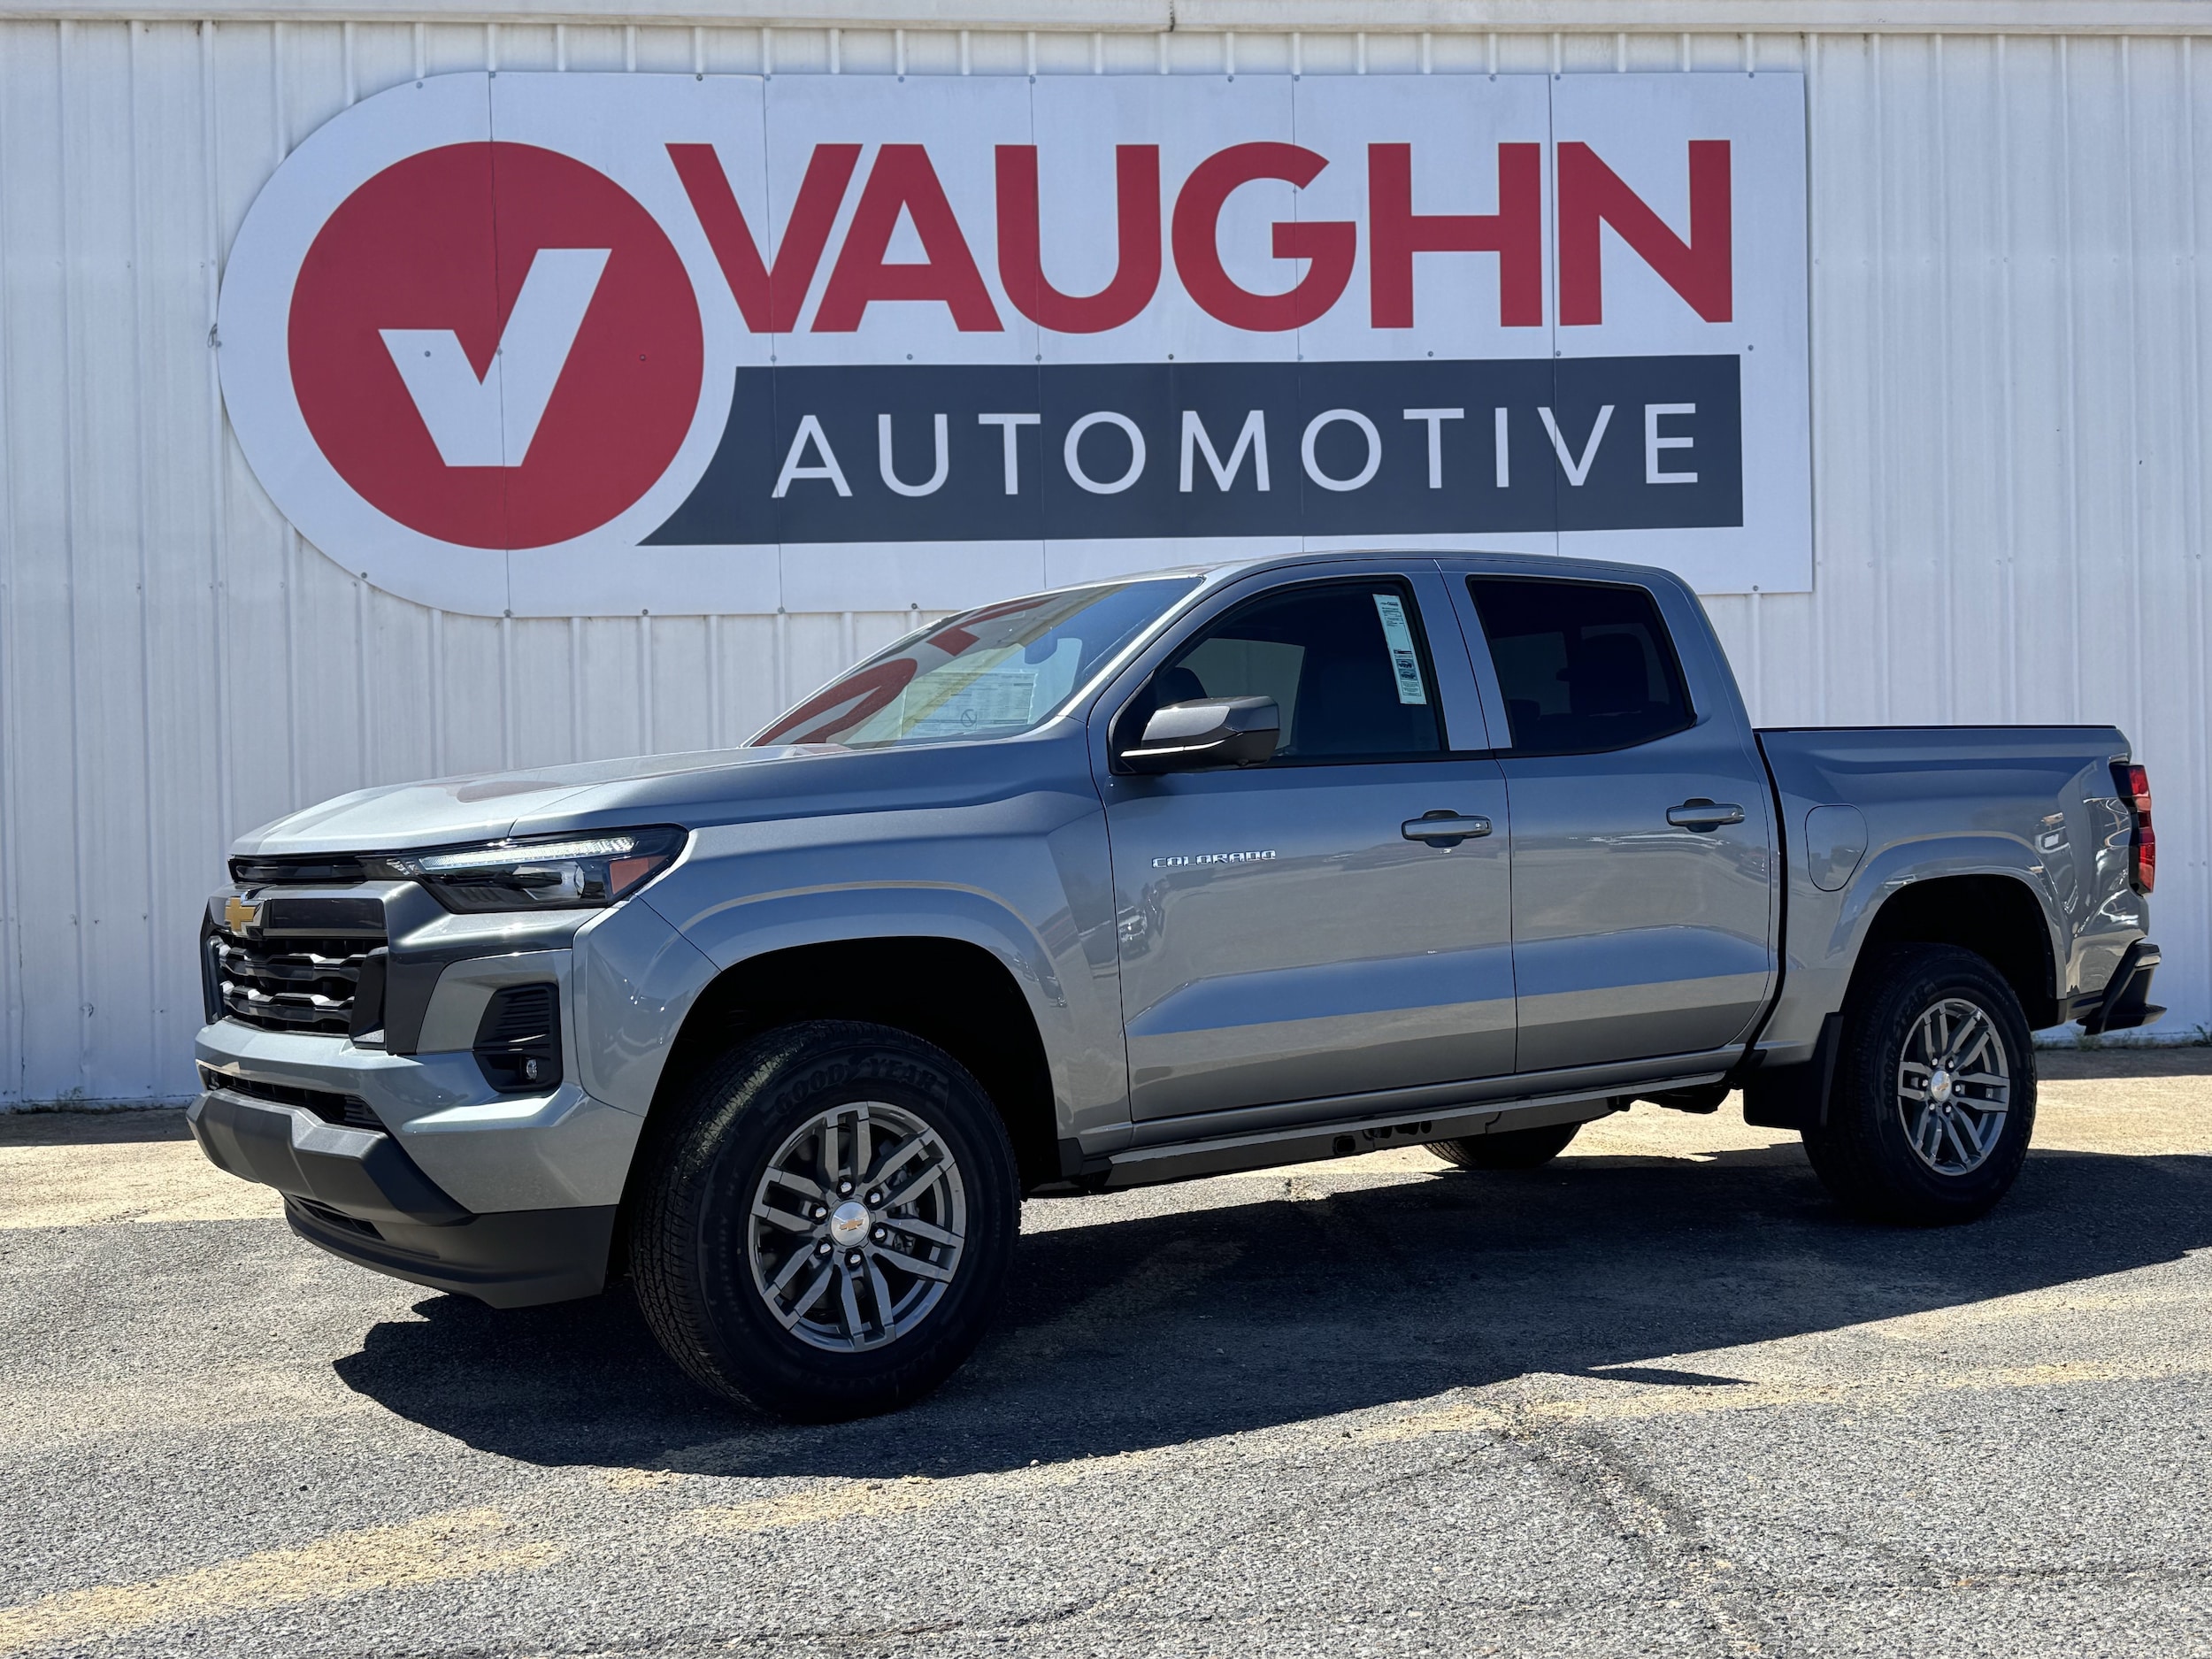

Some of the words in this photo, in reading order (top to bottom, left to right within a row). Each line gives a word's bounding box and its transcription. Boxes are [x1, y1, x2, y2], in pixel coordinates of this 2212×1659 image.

[665, 141, 1732, 333] VAUGHN
[771, 403, 1700, 499] AUTOMOTIVE
[1151, 849, 1277, 869] COLORADO
